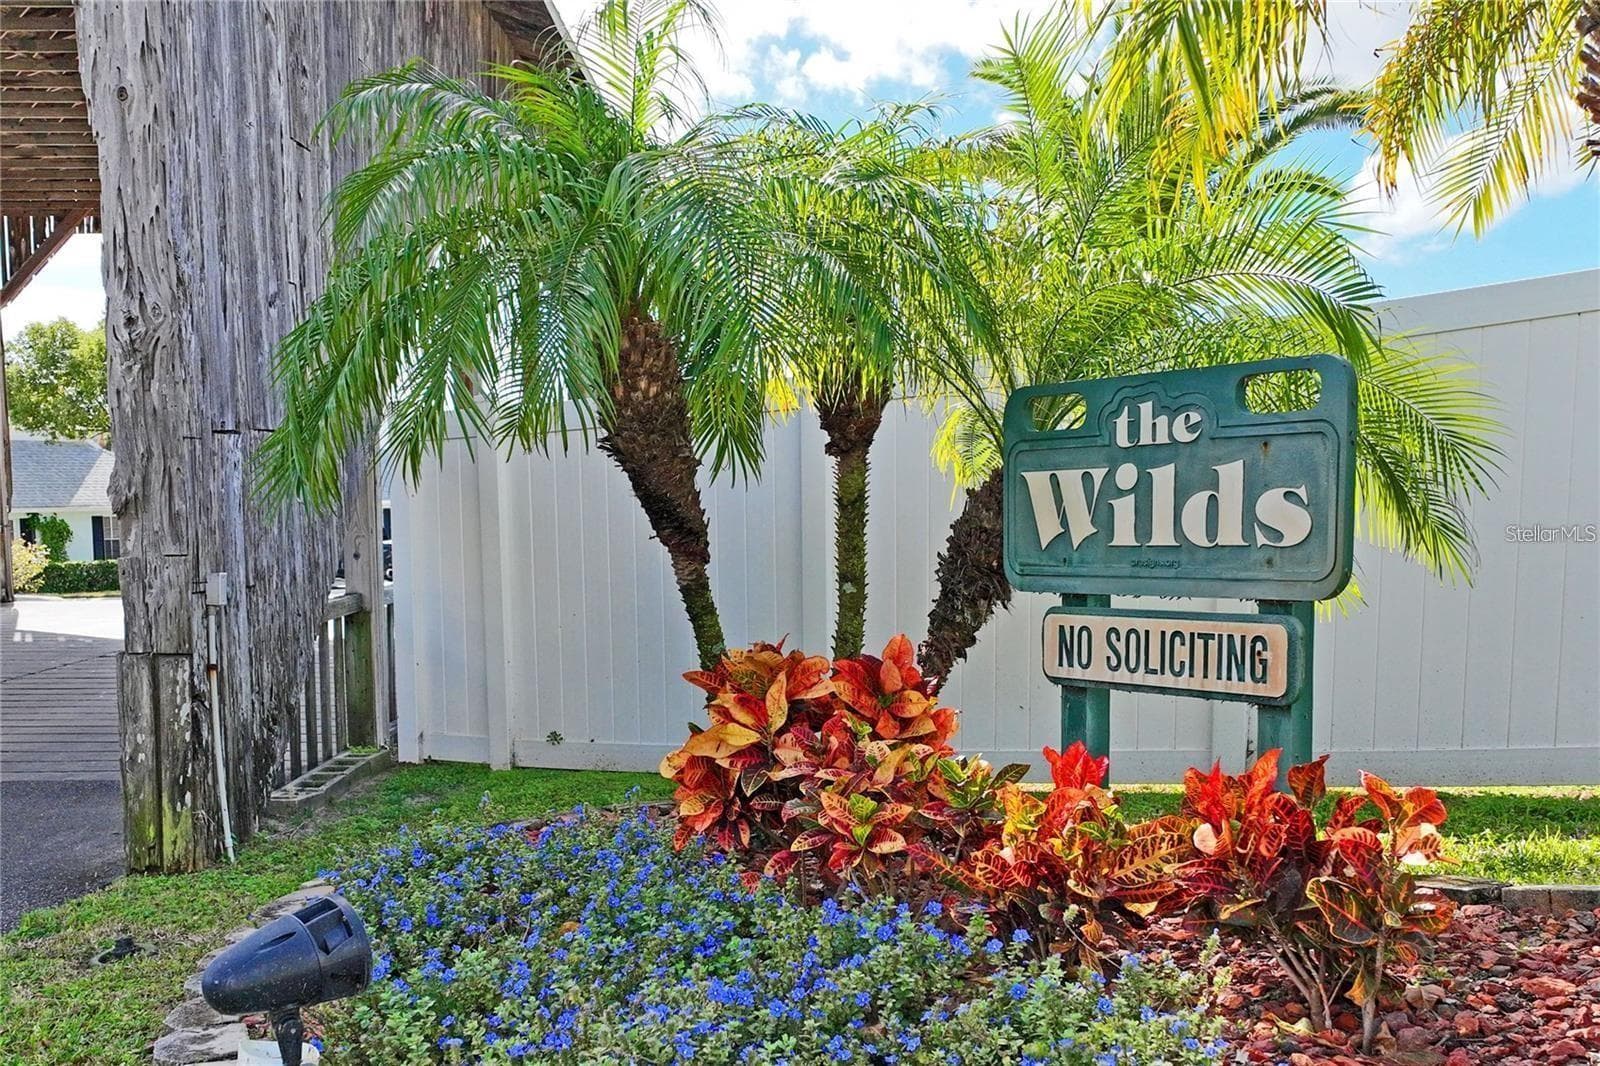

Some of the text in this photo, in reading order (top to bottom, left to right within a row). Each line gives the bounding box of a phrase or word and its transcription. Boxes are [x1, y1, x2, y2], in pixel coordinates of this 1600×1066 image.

[1113, 400, 1203, 448] the
[1020, 459, 1312, 551] Wilds
[1057, 624, 1268, 684] NO SOLICITING
